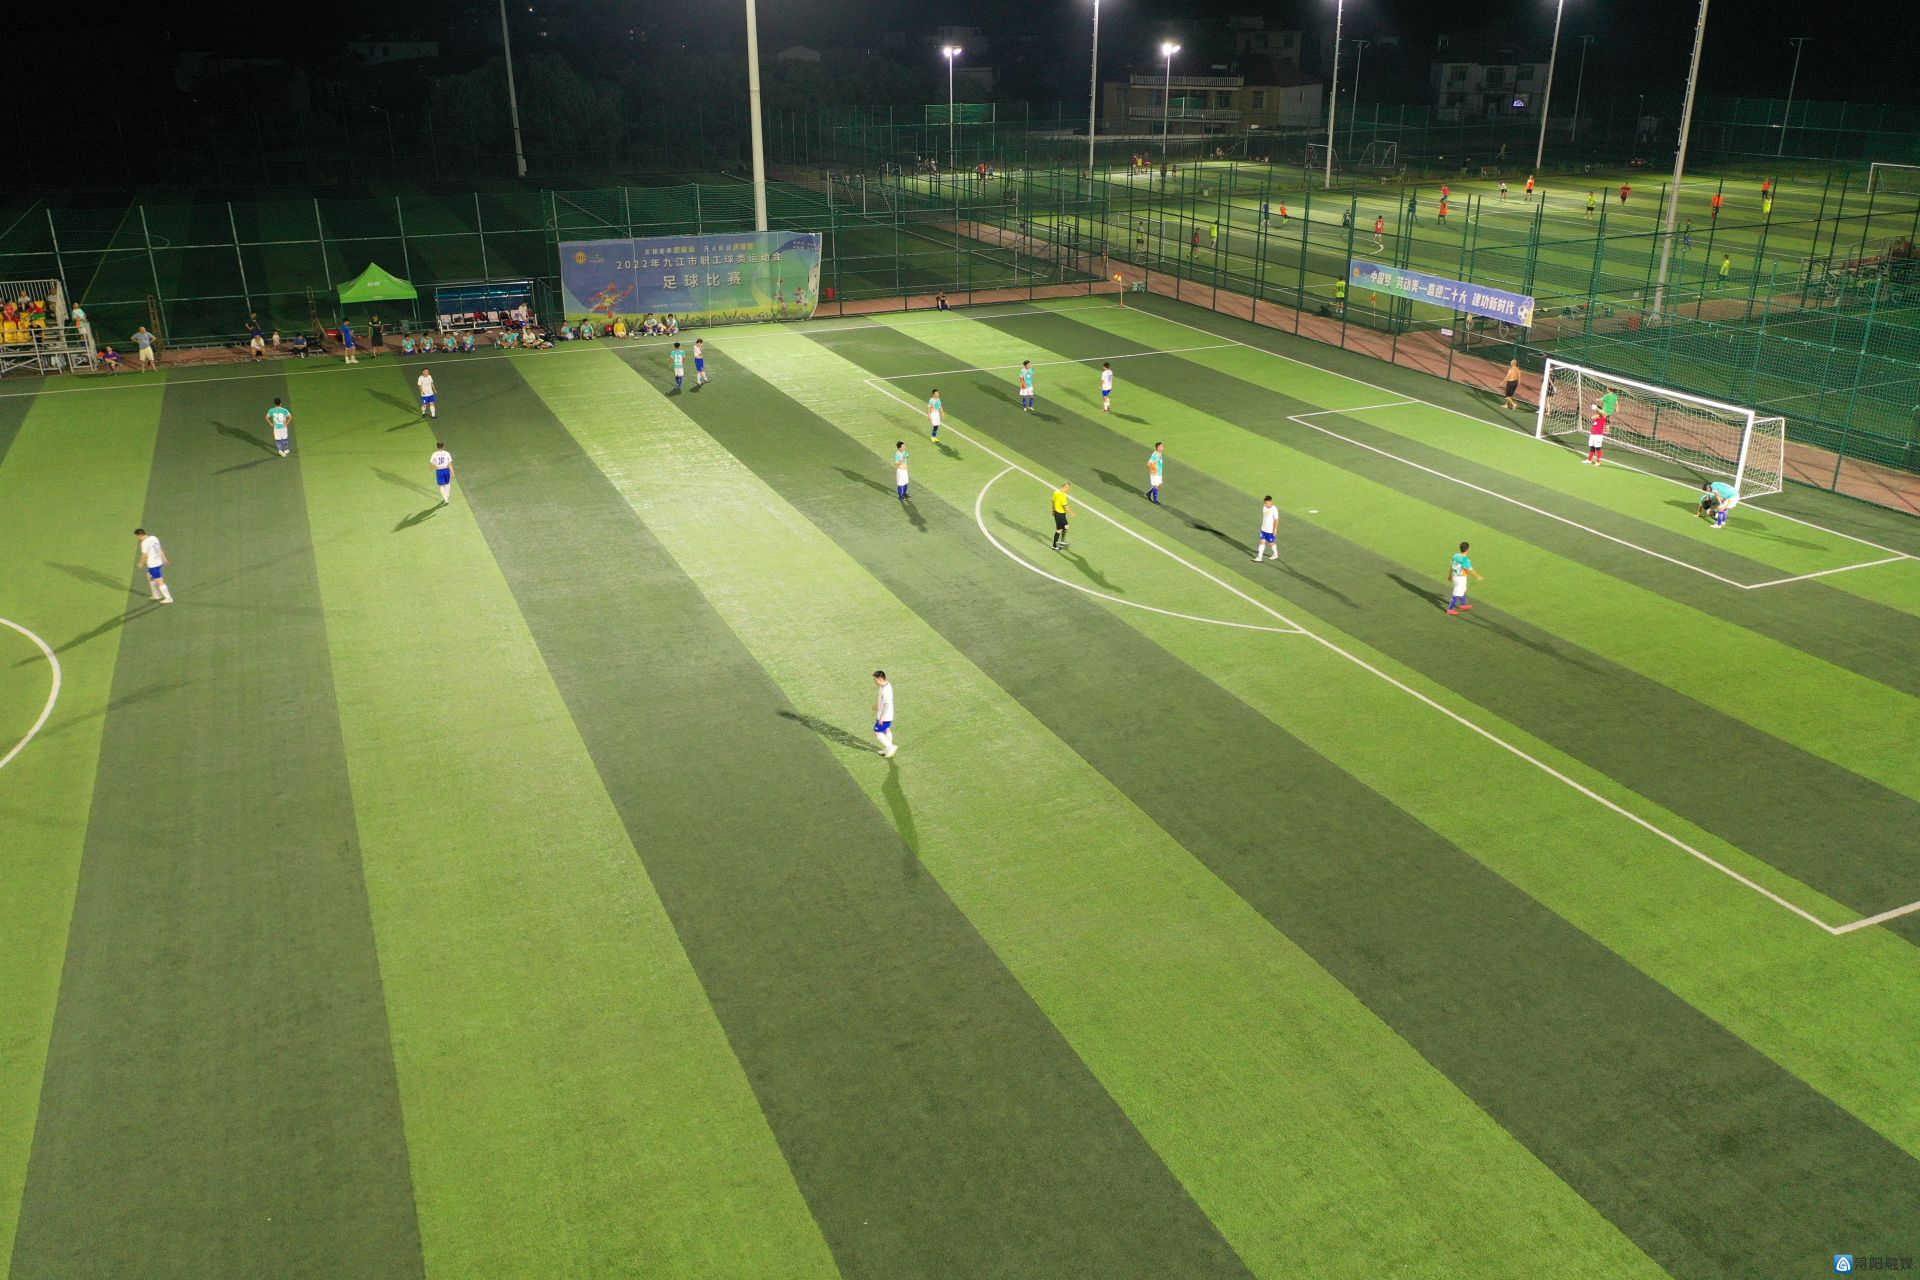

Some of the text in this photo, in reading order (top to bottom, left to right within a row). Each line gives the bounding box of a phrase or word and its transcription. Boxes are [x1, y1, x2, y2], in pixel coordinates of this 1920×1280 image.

[616, 252, 782, 270] 2022年九江市职工球类运动会
[663, 271, 742, 290] 足球比赛
[1472, 292, 1515, 315] 建功新时代
